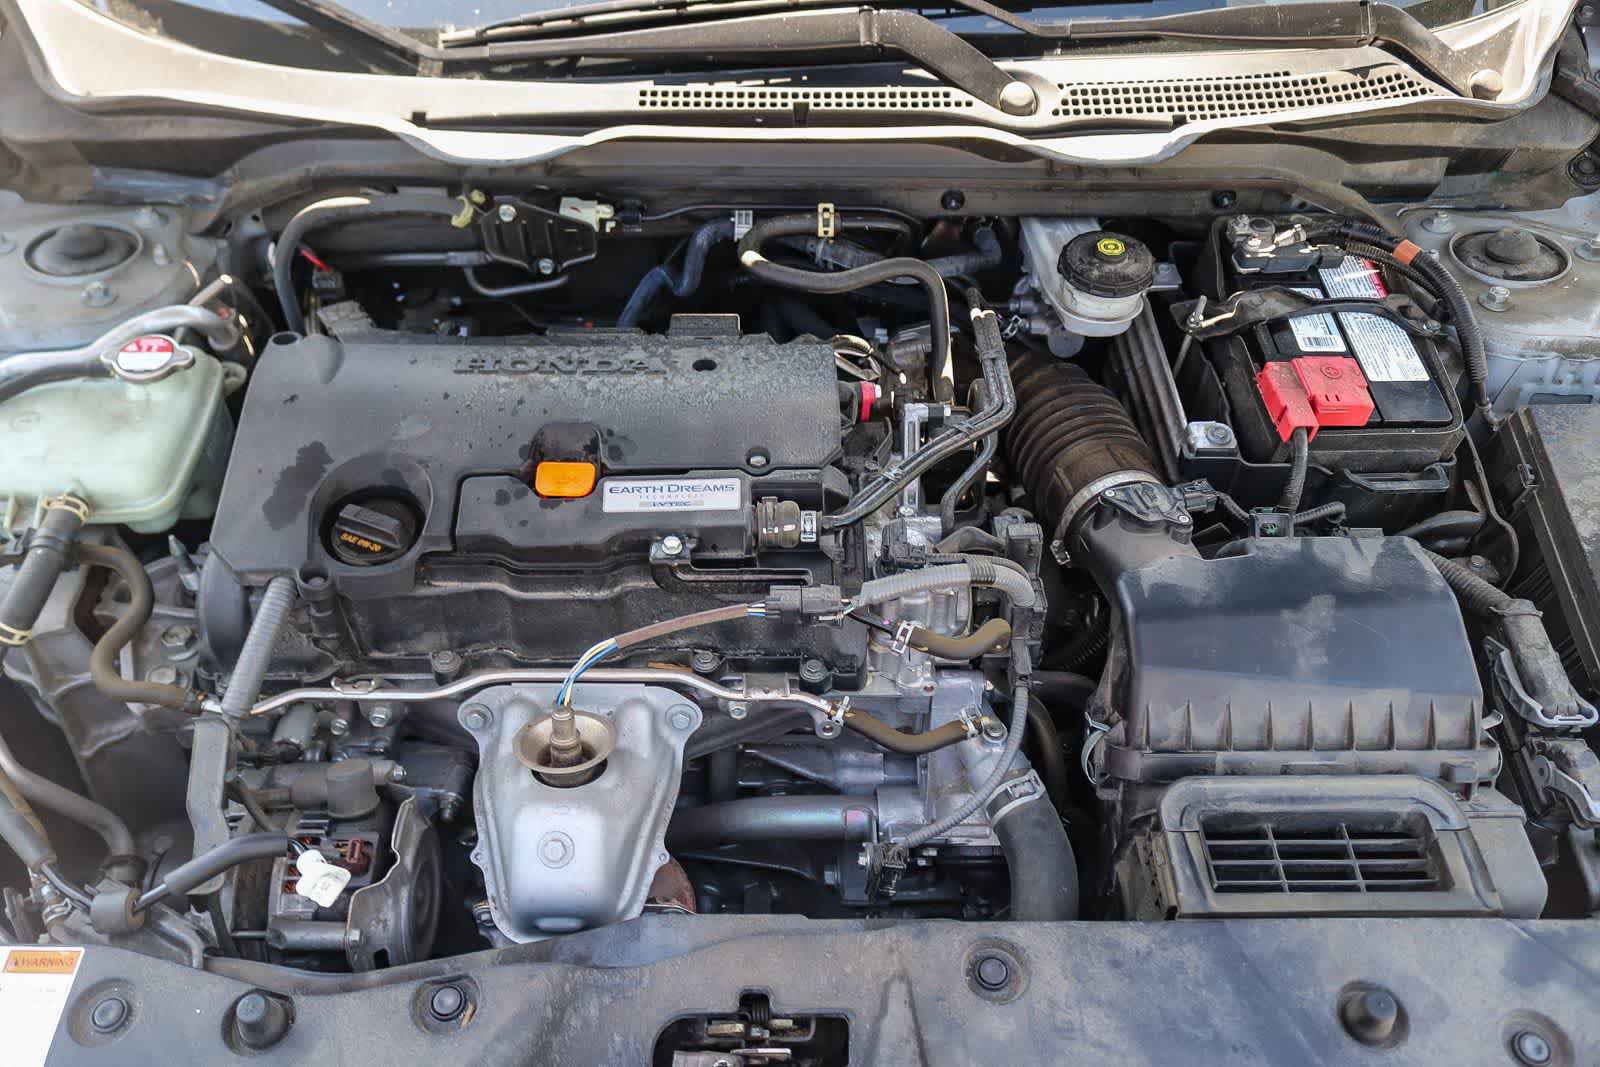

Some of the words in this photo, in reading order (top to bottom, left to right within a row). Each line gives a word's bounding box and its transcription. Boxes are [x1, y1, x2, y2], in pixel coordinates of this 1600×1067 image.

[453, 358, 667, 374] HONDA
[609, 486, 663, 494] EARTH
[667, 484, 735, 493] DREAMS
[22, 957, 74, 967] WARNING
